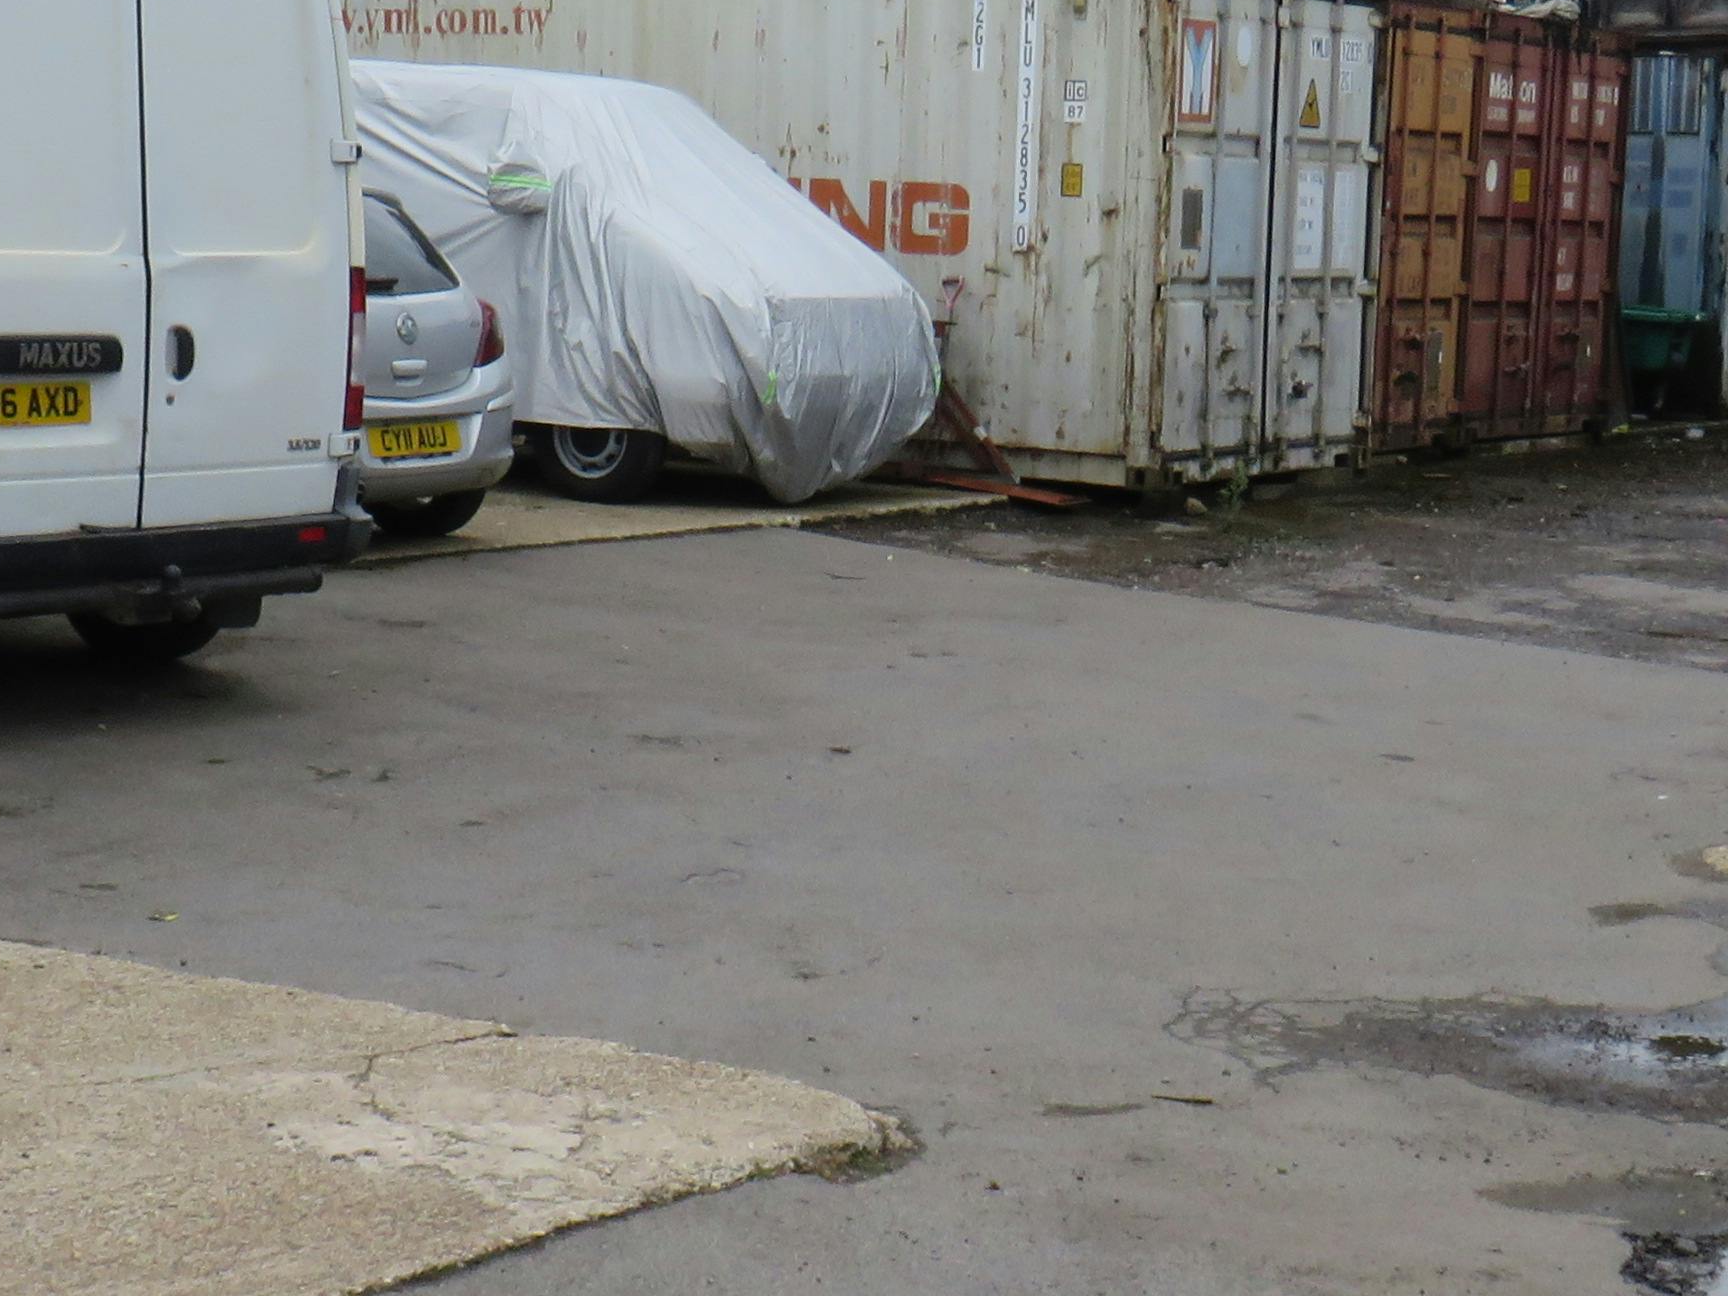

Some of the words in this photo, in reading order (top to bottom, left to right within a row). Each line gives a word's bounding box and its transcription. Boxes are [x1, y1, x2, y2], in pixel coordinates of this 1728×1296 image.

[1489, 71, 1537, 104] Maton
[1018, 76, 1032, 214] 312835
[786, 176, 971, 256] NG
[18, 341, 102, 369] MAXUS
[27, 386, 80, 417] AXD
[380, 427, 414, 452] CY11
